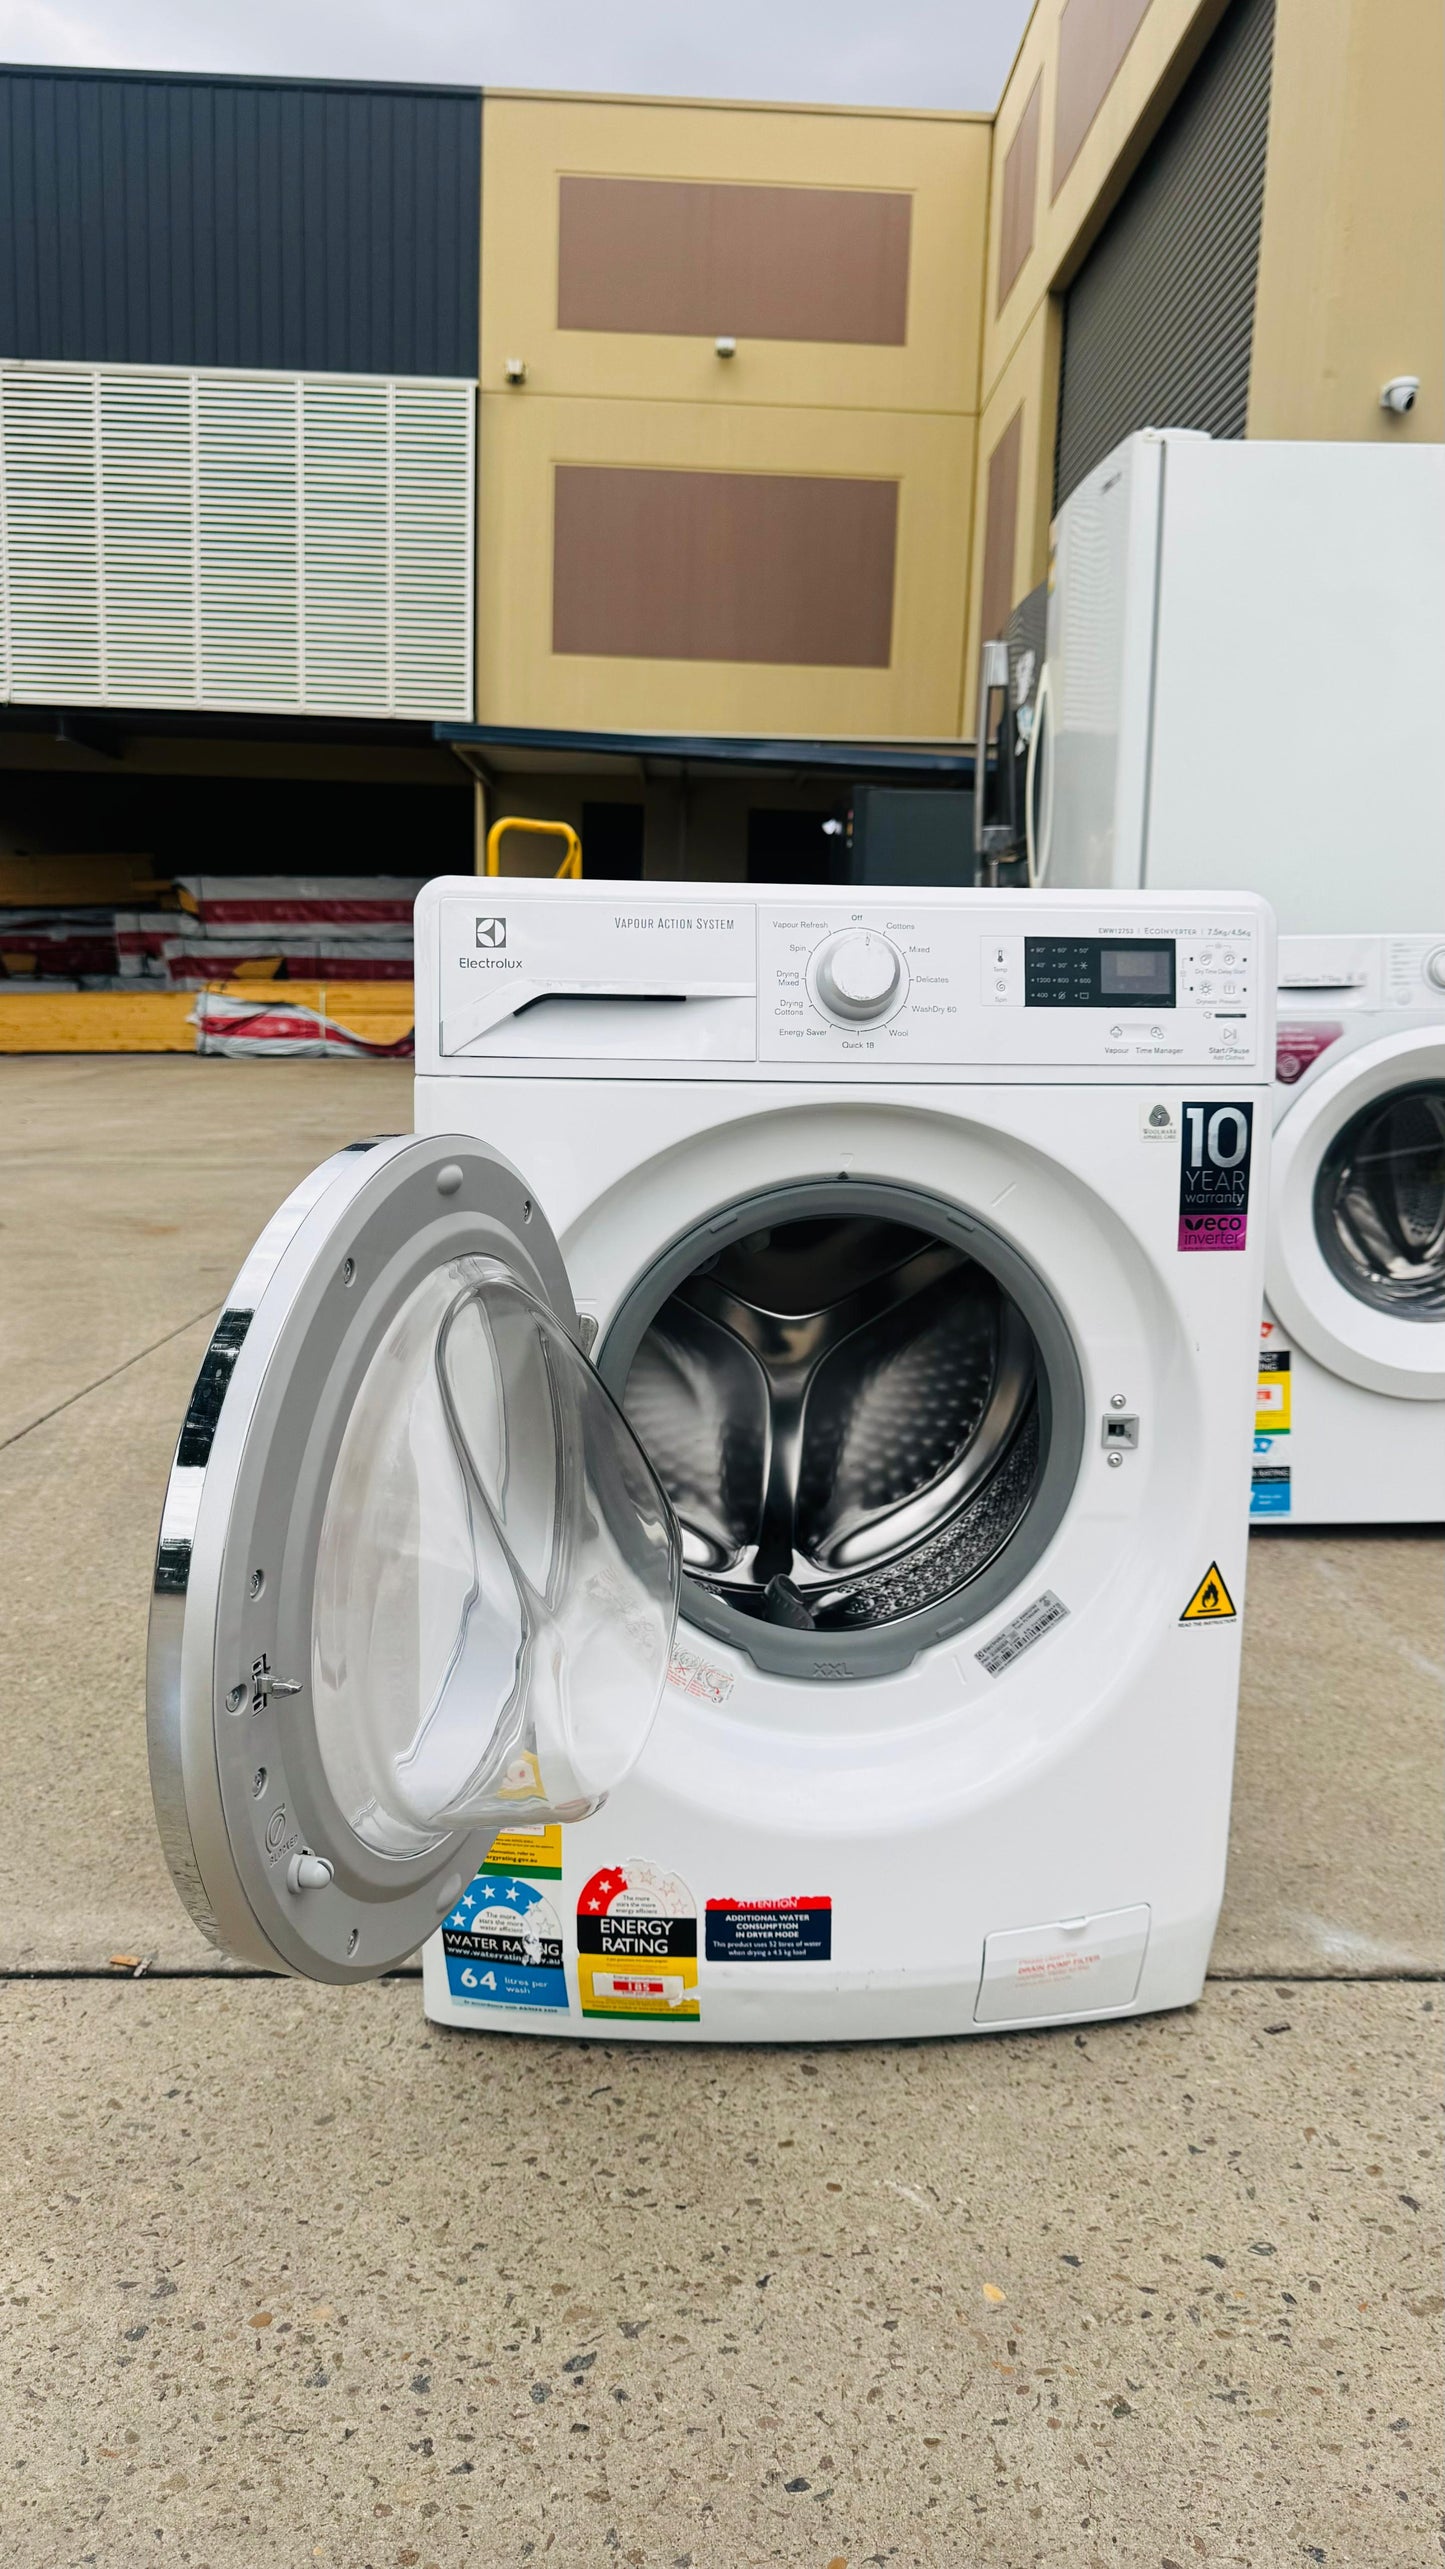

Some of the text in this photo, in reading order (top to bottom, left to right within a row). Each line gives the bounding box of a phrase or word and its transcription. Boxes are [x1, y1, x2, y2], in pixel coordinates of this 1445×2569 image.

[615, 917, 735, 930] VAPOUR ACTION SYSTEM
[773, 921, 798, 929] Vapour
[886, 922, 915, 930] Cottons
[459, 958, 523, 969] Electrolux
[776, 970, 799, 978] Drying
[780, 1000, 803, 1008] Drying
[912, 1005, 945, 1014] WashDry
[774, 1008, 804, 1016] Cottons
[779, 1028, 804, 1037] Energy
[842, 1041, 863, 1049] Quick
[1154, 1047, 1184, 1056] Manager
[1186, 1107, 1248, 1168] 10
[1186, 1171, 1245, 1191] YEAR
[1185, 1192, 1244, 1206] warranty
[1204, 1218, 1241, 1230] eco
[1184, 1232, 1239, 1245] inverter
[812, 1662, 854, 1677] XXL
[600, 1919, 673, 1935] ENERGY
[445, 1933, 559, 1956] WATER RANG
[602, 1938, 668, 1953] RATING
[461, 1968, 497, 1991] 64
[504, 1977, 529, 1986] litres
[506, 1986, 530, 1994] wash
